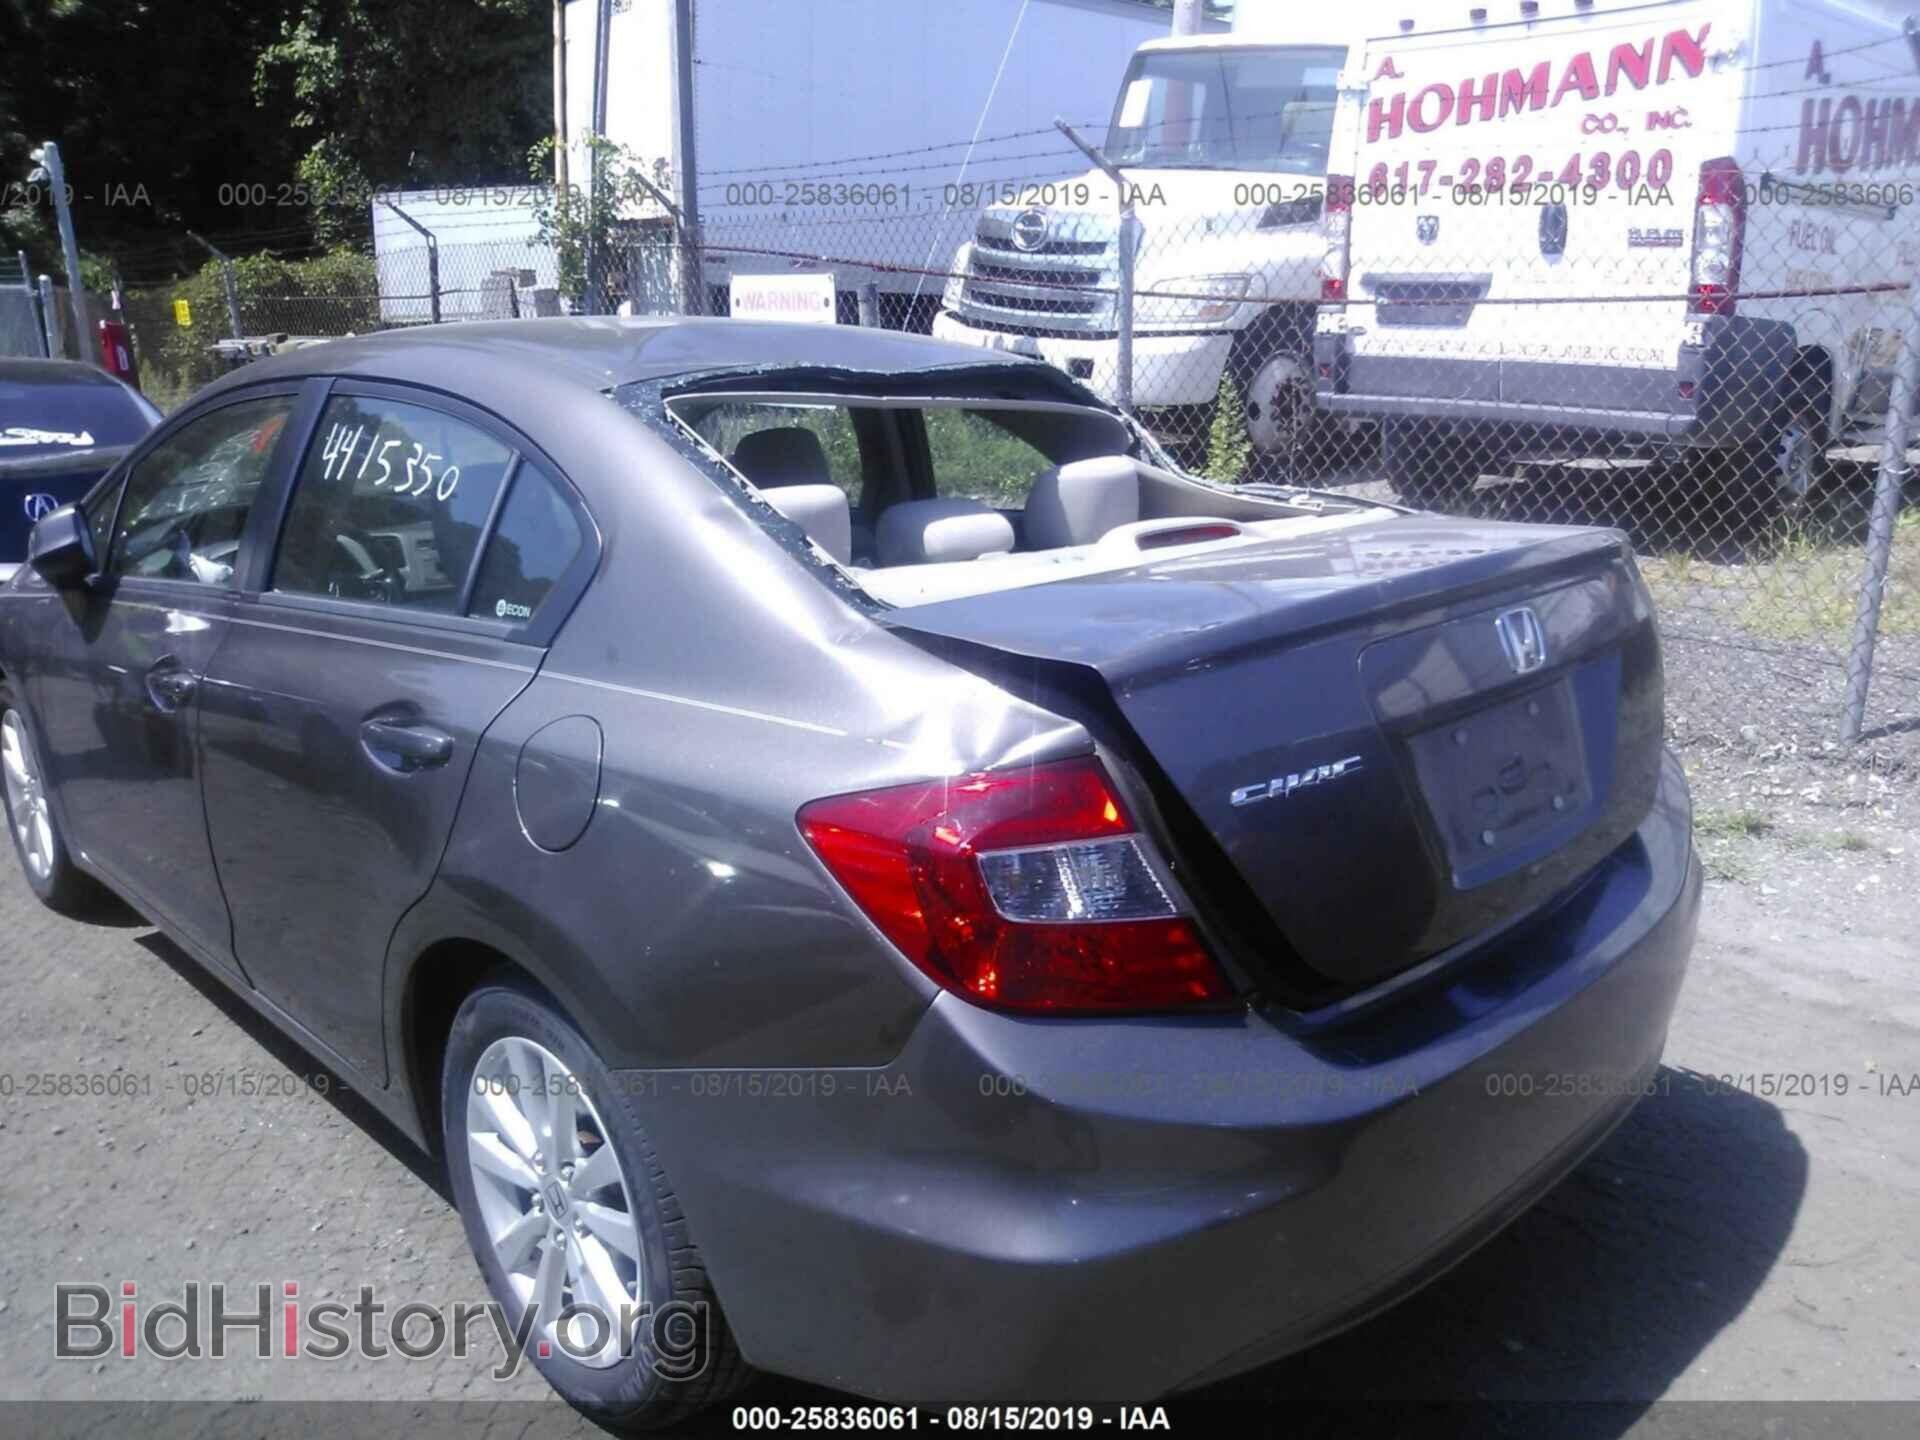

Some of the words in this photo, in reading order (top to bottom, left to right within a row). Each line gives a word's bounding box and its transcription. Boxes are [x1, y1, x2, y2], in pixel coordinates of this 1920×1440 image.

[1366, 22, 1712, 143] HOHMANN
[741, 291, 820, 312] WARNING
[322, 423, 459, 500] 4415350
